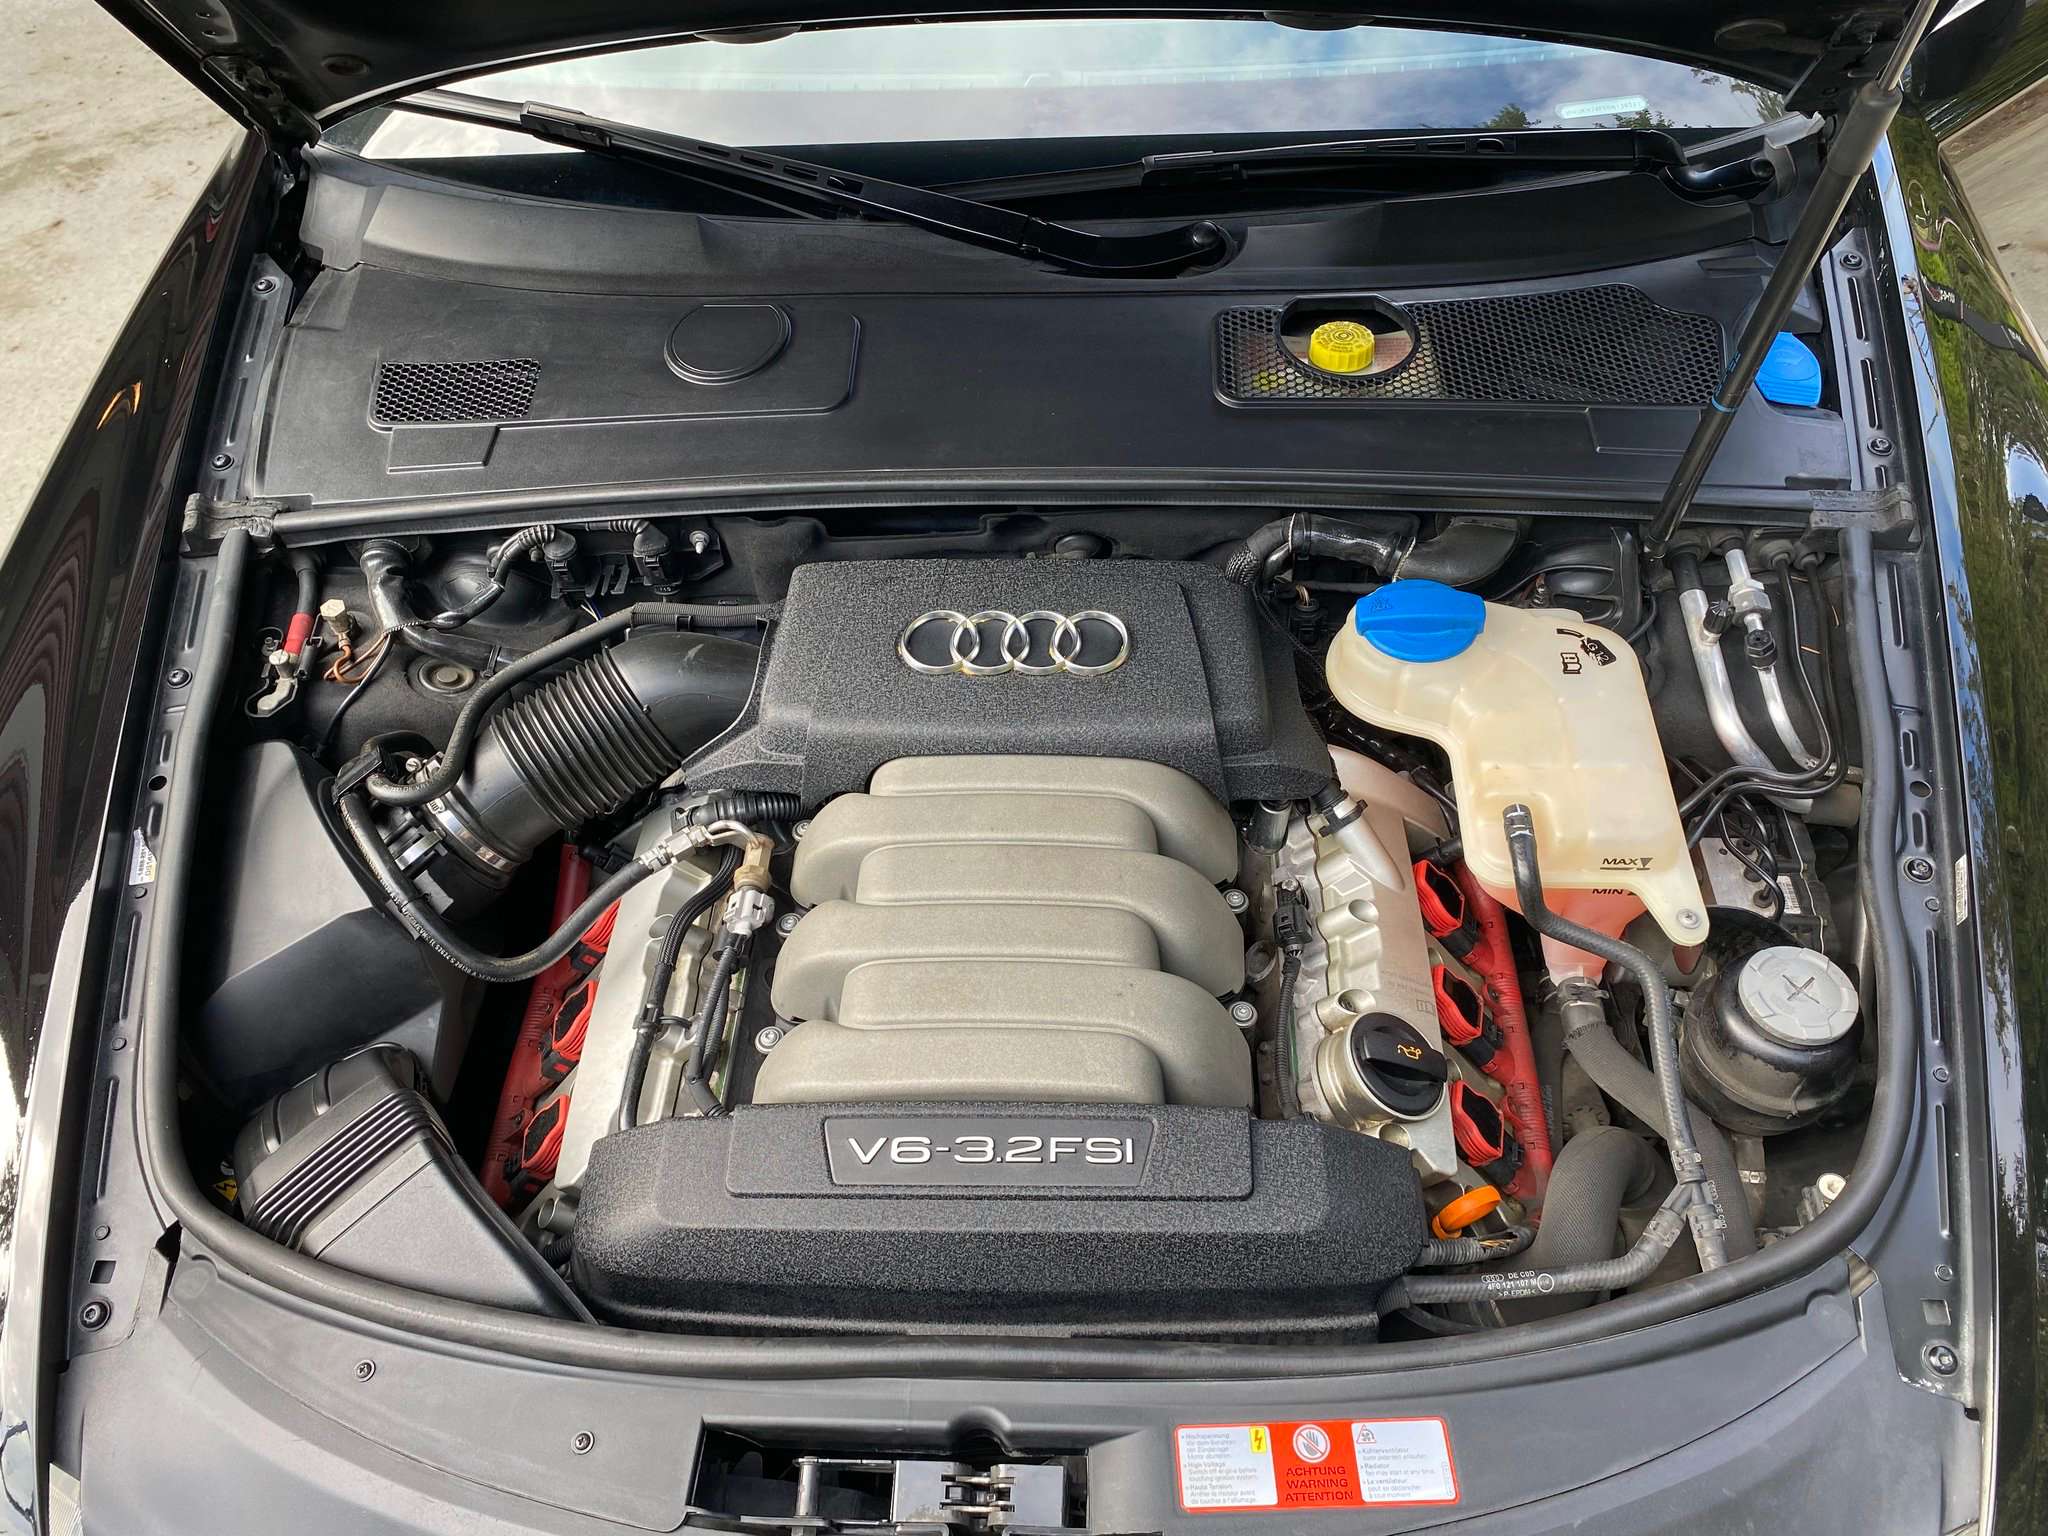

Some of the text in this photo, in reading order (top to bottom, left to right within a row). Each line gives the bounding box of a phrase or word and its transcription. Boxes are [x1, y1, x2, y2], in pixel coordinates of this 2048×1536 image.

[1602, 858, 1639, 866] MAX
[1502, 1280, 1514, 1288] 121
[1286, 1466, 1346, 1476] ACHTUNG
[1286, 1478, 1348, 1489] WARNING
[1285, 1490, 1353, 1502] ATTENTION
